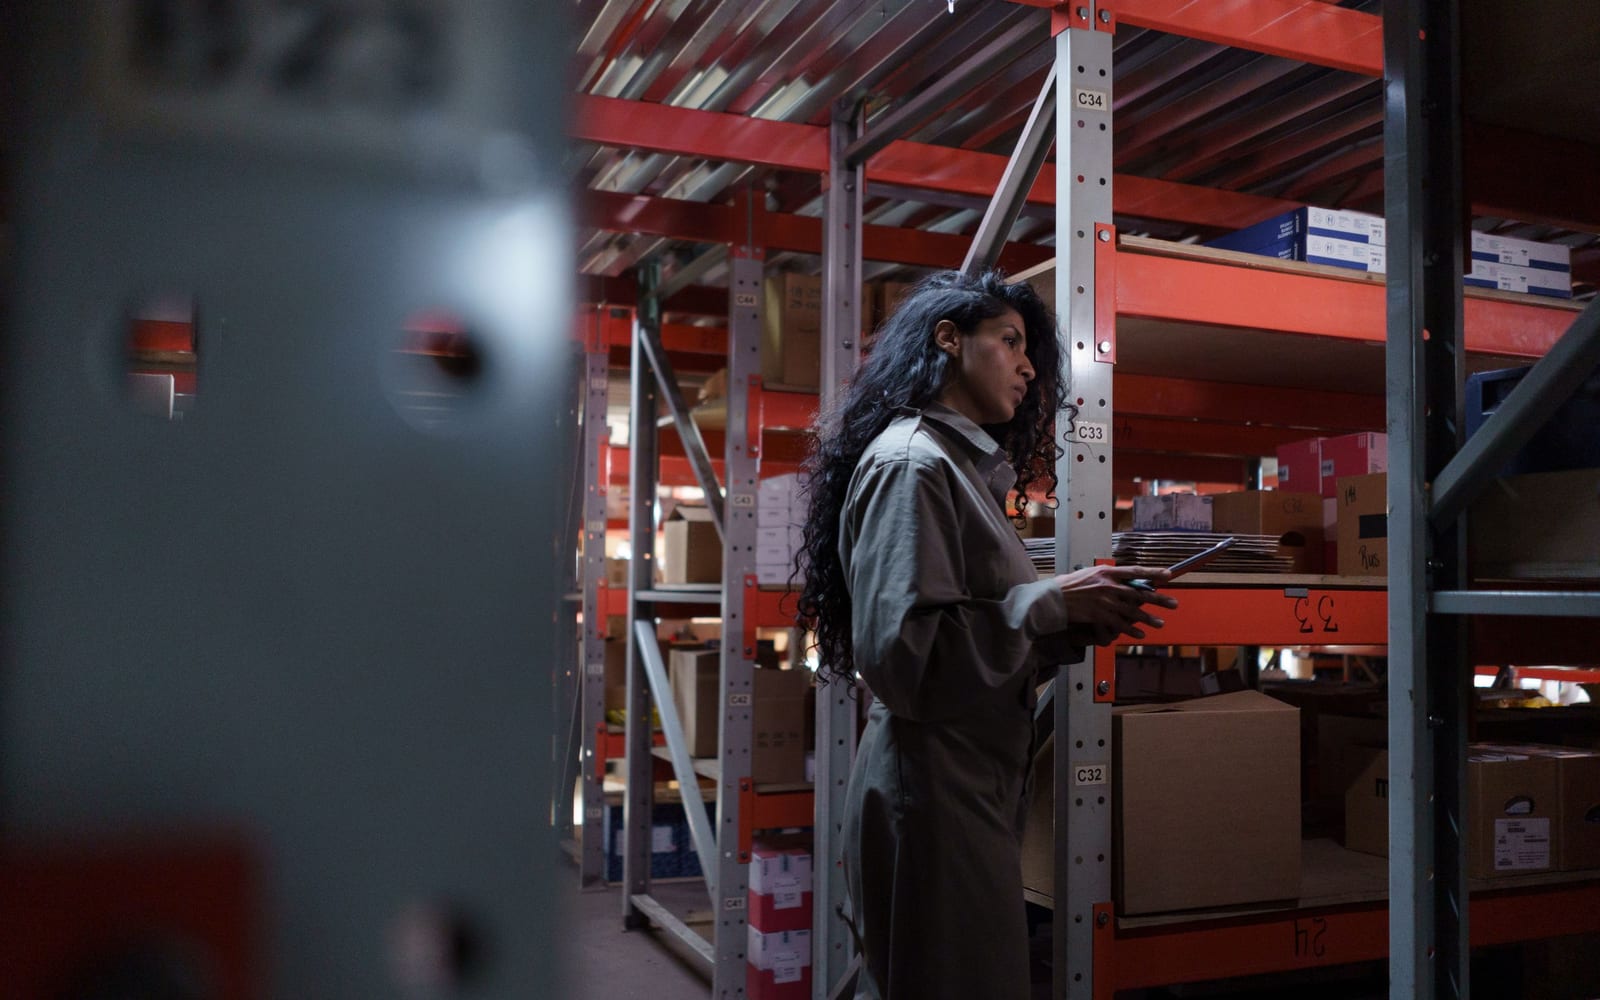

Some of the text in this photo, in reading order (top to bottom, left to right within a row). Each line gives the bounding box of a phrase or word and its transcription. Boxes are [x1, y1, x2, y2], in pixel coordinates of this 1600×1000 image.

[1078, 92, 1102, 107] C34
[737, 295, 754, 304] C44
[1078, 425, 1103, 440] C33
[734, 496, 751, 504] C43
[1294, 595, 1338, 632] 33
[731, 695, 748, 704] C42
[1077, 768, 1102, 783] C32
[726, 899, 742, 908] C41
